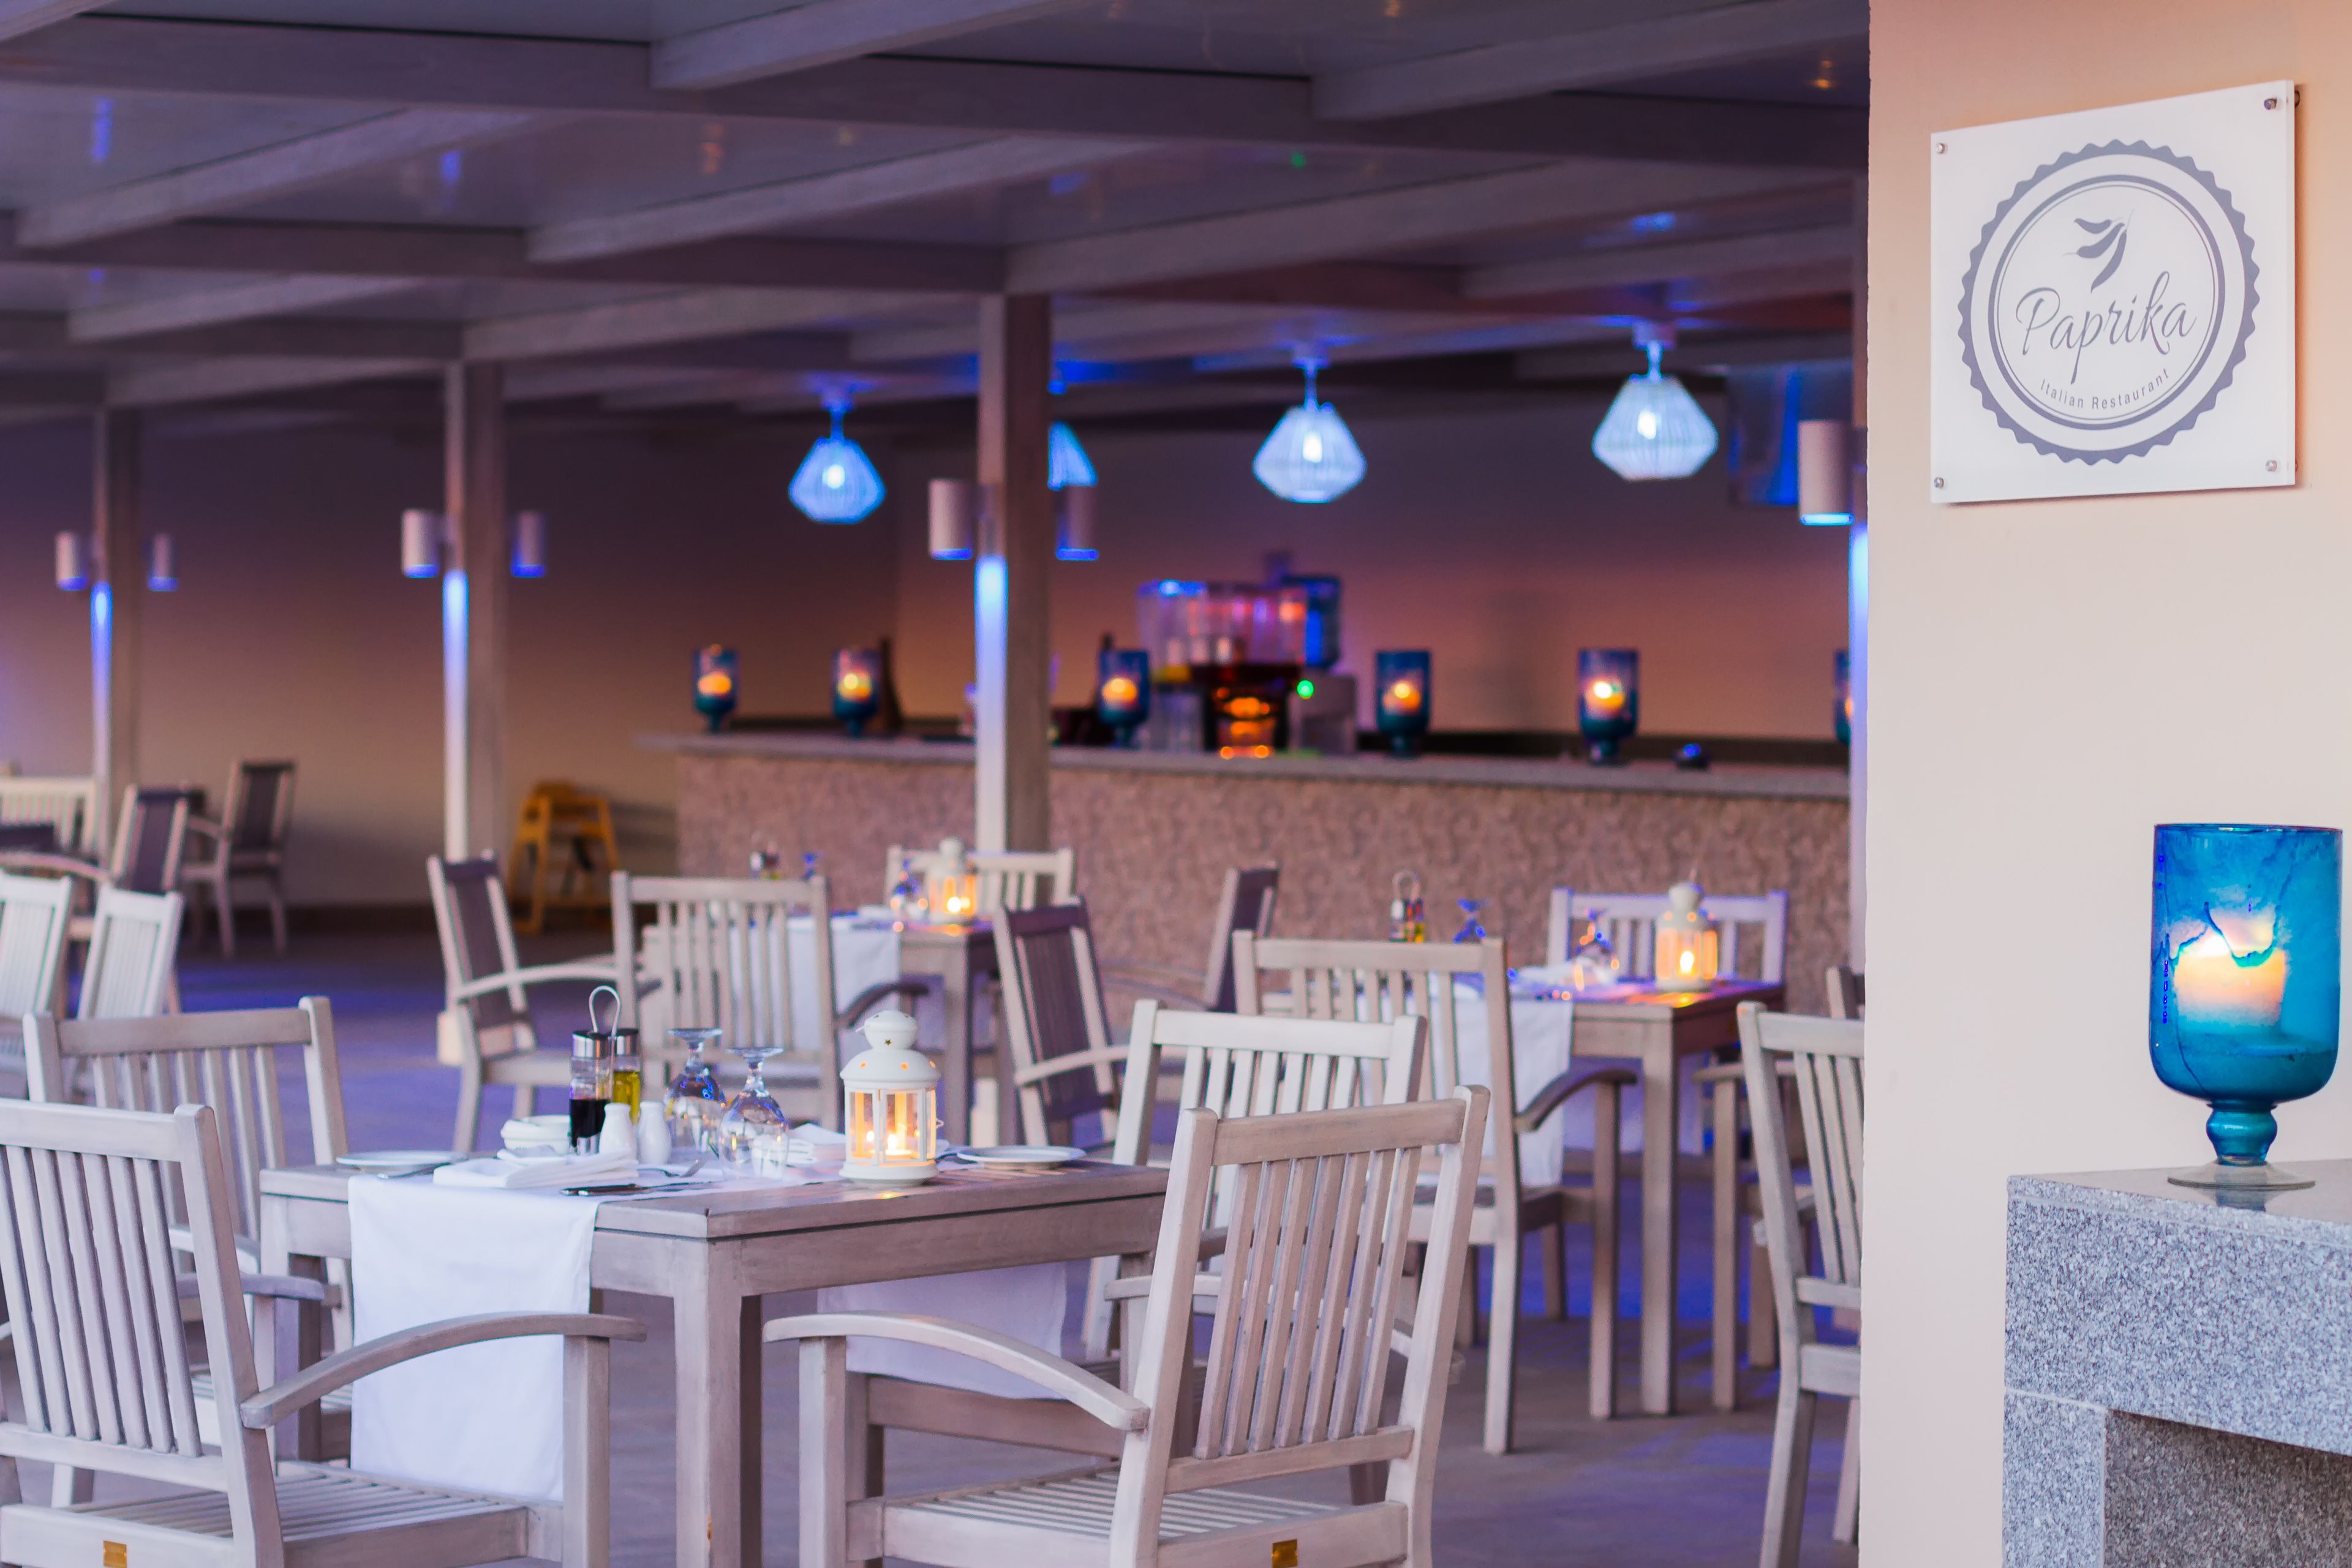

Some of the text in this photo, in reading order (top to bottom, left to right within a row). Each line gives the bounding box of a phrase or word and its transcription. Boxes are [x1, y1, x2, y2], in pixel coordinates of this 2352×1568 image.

[2016, 271, 2197, 385] Paprika
[2041, 368, 2169, 409] Italian Restaurant
